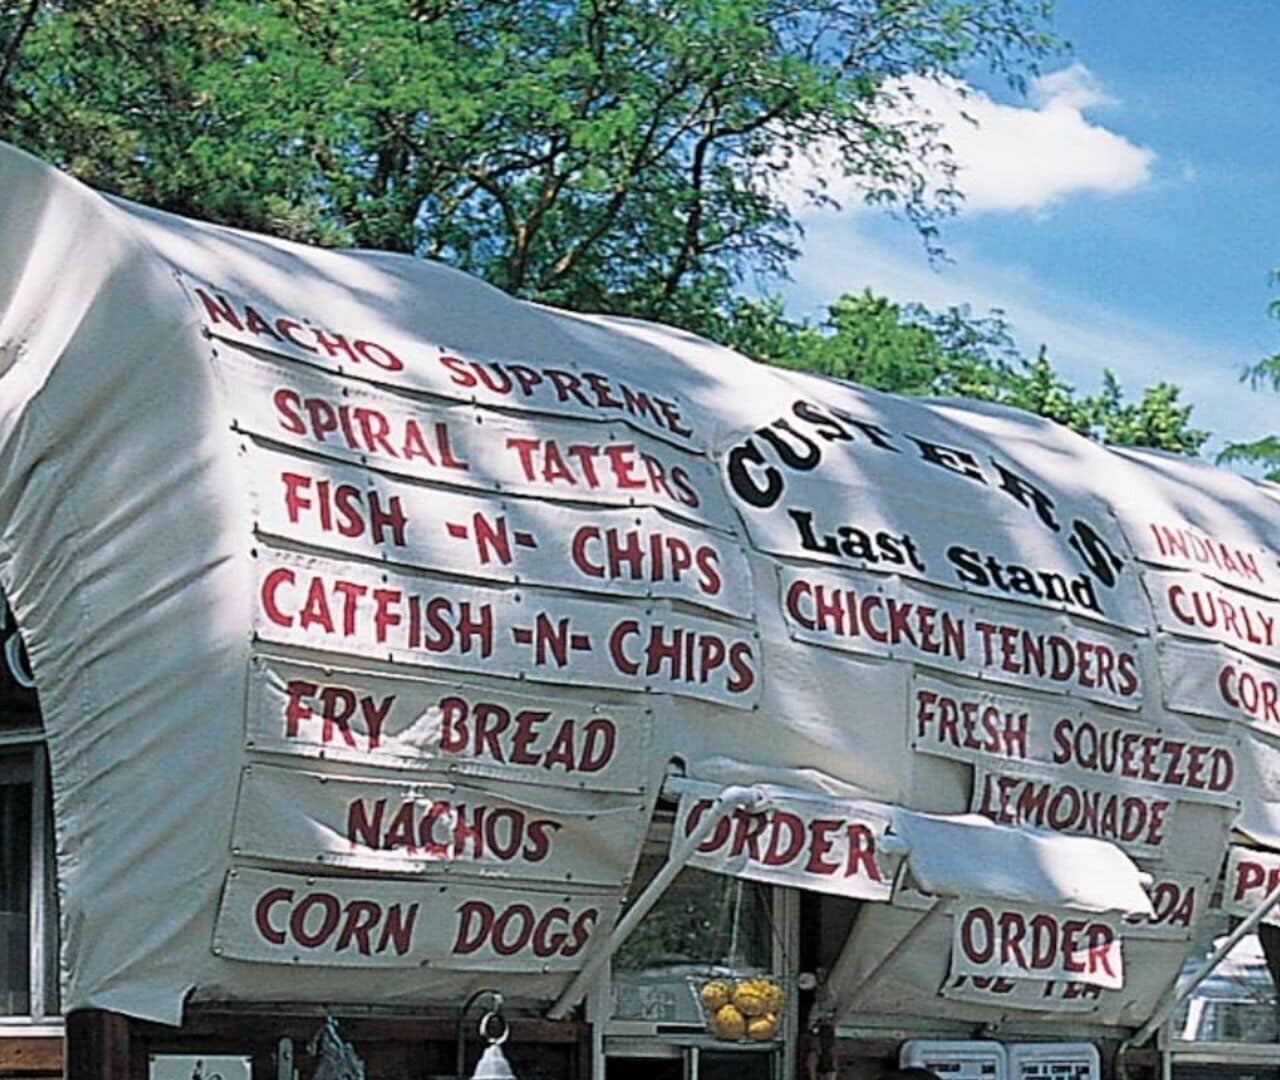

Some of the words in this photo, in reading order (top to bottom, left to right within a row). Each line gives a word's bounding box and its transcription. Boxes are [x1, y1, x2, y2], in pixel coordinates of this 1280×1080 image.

[195, 287, 404, 372] NACHO
[439, 353, 694, 440] SUPREME
[273, 387, 469, 471] SPIRAL
[506, 436, 702, 508] TATERS
[280, 472, 407, 547] FISH
[446, 510, 538, 566] -N-
[571, 525, 722, 596] CHIPS
[788, 508, 926, 572] Last
[947, 546, 1104, 614] Stand
[1150, 522, 1263, 584] INDIAN
[260, 568, 494, 658] CATFISH
[512, 612, 593, 667] -N-
[608, 620, 753, 694] CHIPS
[786, 580, 966, 662] CHICKEN
[975, 622, 1138, 697] TENDERS
[1167, 584, 1274, 646] CURLY
[285, 680, 396, 752] FRY
[439, 698, 616, 774] BREAD
[917, 690, 1028, 758] FRESH
[1053, 719, 1235, 792] SQUEEZED
[347, 798, 562, 863] NACHOS
[683, 797, 882, 882] ORDER
[978, 774, 1167, 845] LEMONADE
[254, 887, 418, 956] CORN
[452, 899, 598, 958] DOGS
[960, 906, 1116, 978] ORDER
